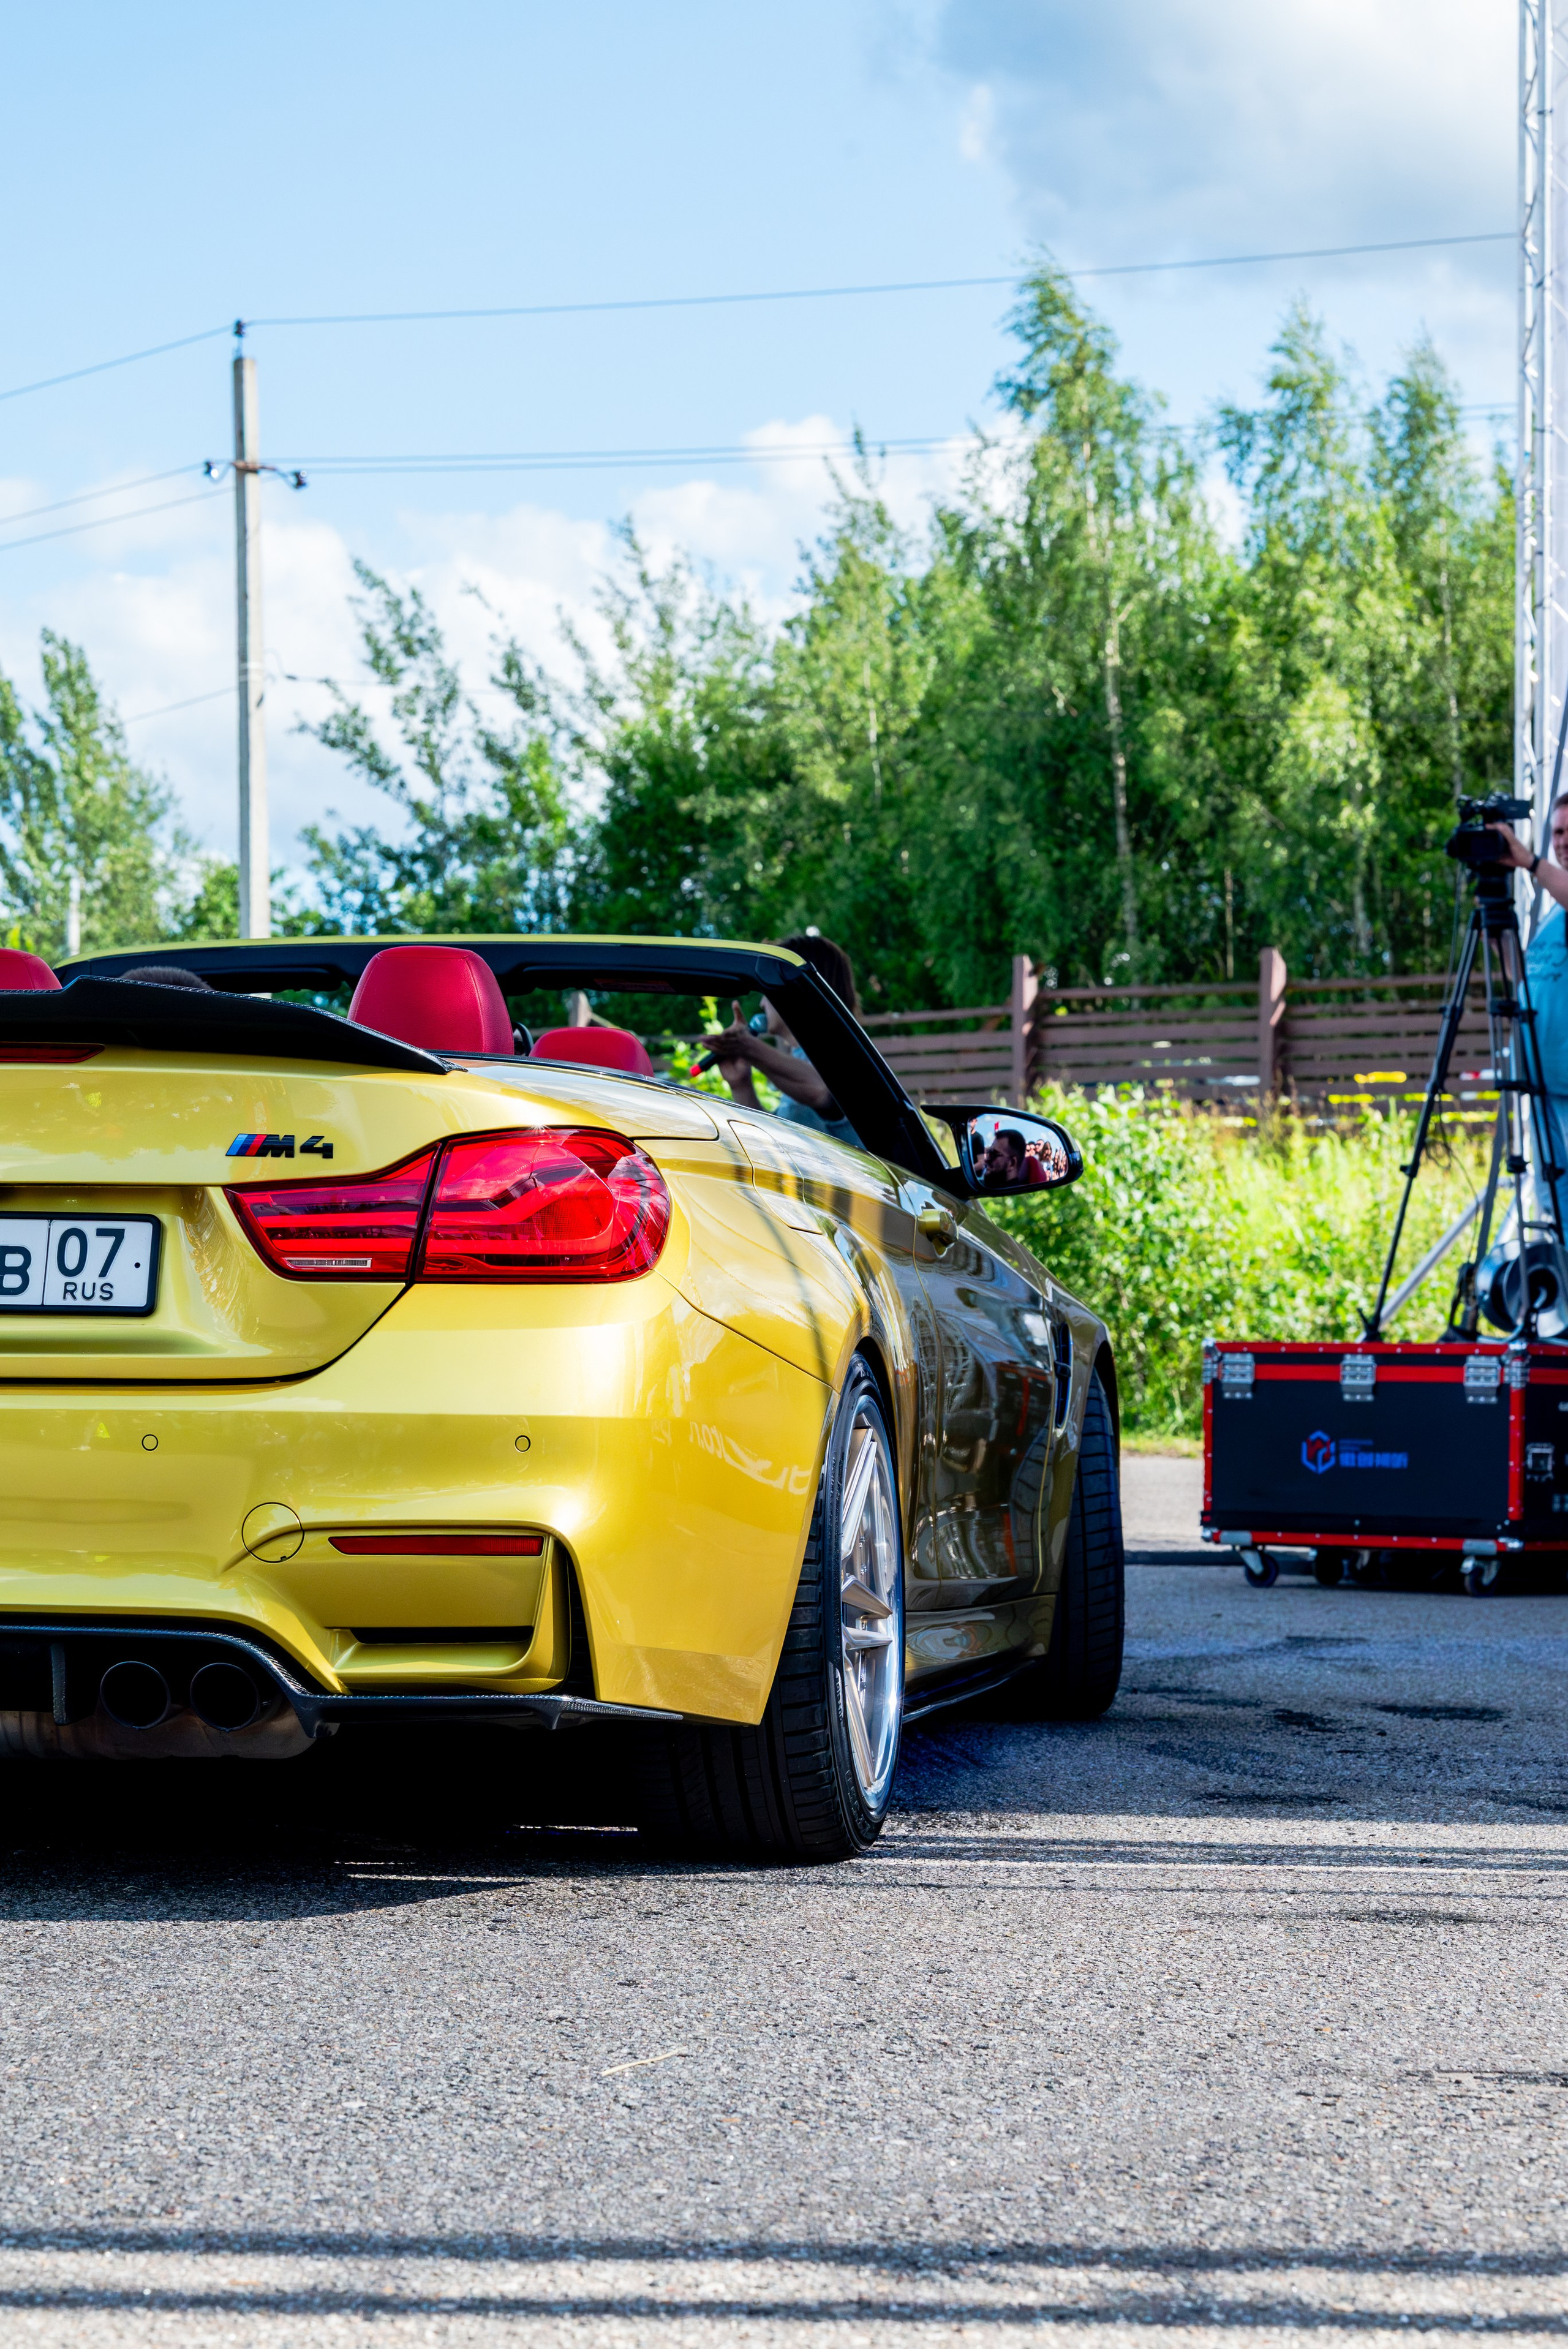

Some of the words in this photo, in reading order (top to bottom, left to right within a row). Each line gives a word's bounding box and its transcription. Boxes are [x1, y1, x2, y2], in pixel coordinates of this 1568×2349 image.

[255, 1134, 334, 1159] M4
[56, 1227, 126, 1278] 07
[62, 1281, 113, 1300] RUS
